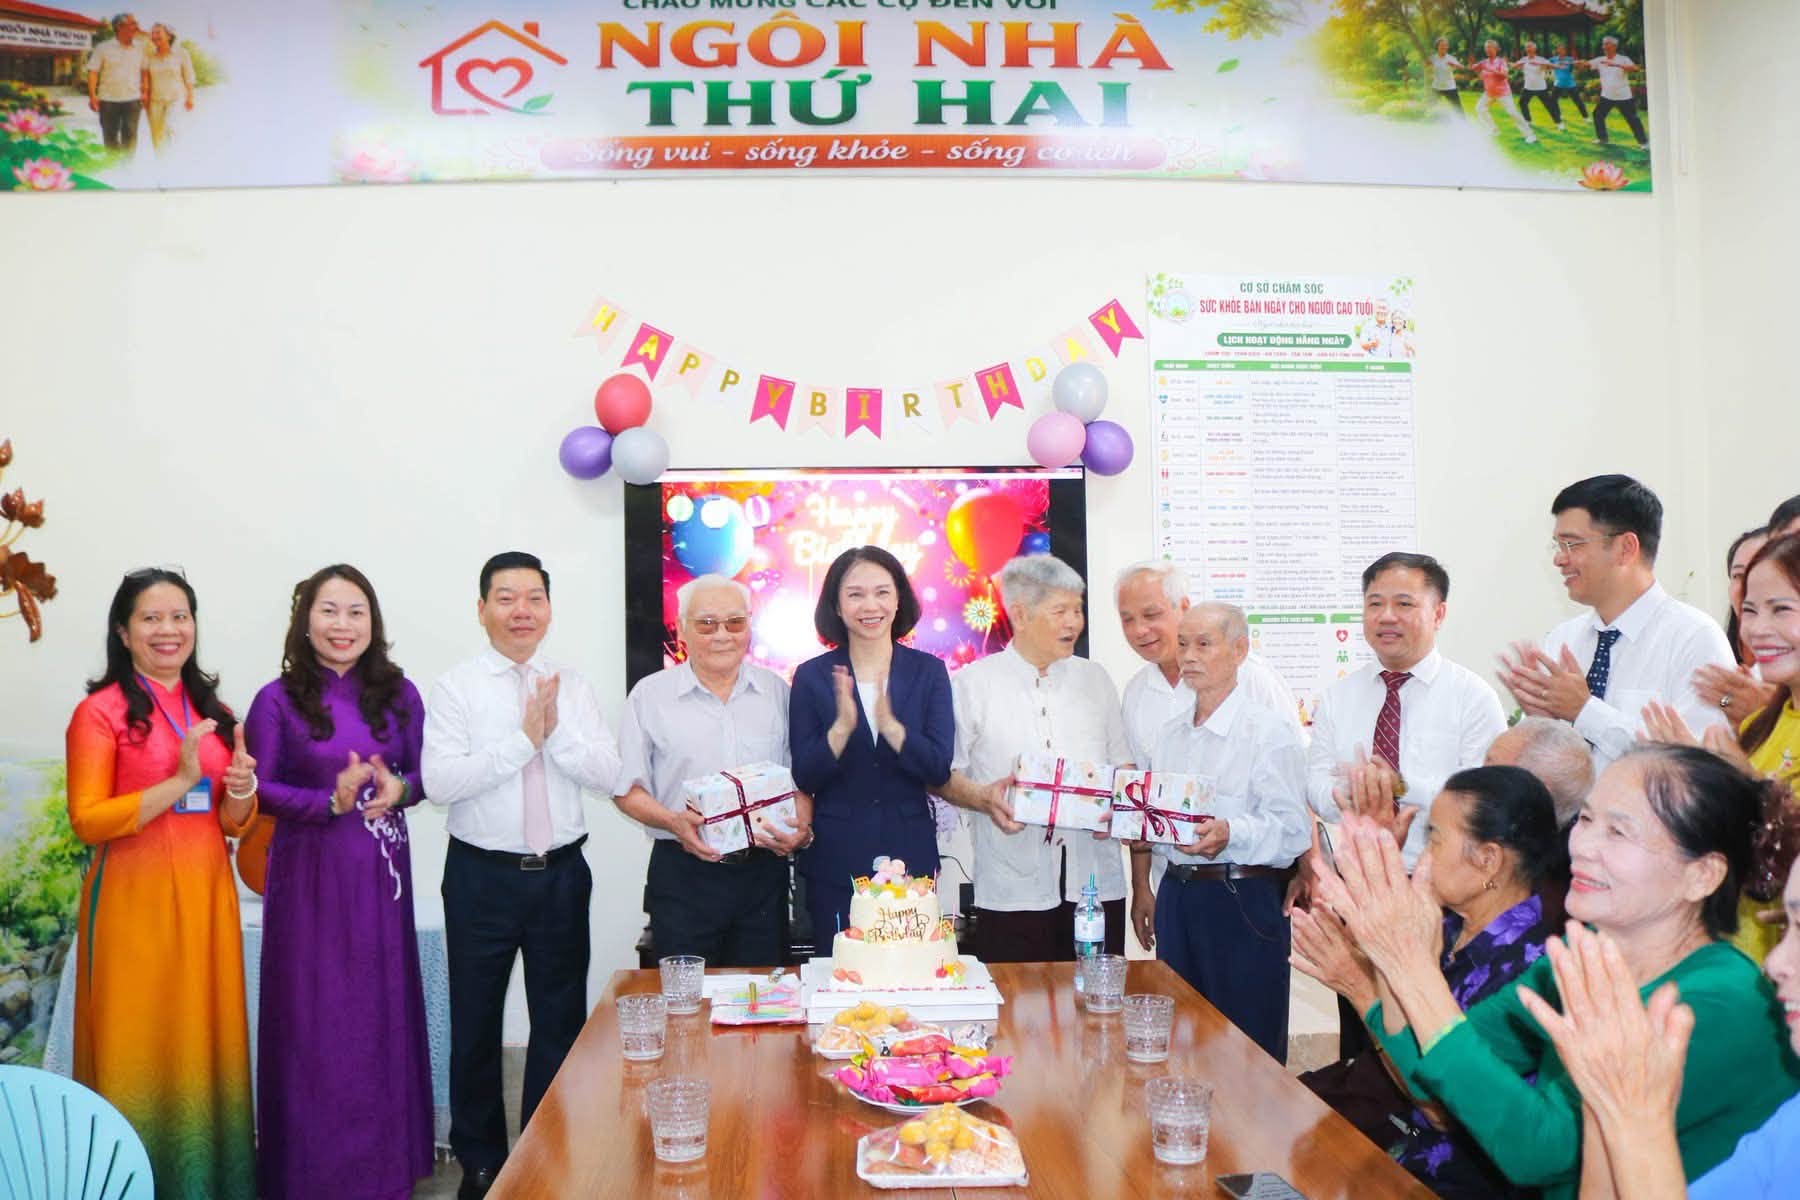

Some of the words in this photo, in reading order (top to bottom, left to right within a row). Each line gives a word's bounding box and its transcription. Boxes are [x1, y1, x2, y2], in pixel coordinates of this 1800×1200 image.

[596, 10, 868, 69] NGÔI
[913, 11, 1174, 71] NHÀ
[625, 68, 872, 127] THỨ
[912, 79, 1133, 129] HAI
[664, 141, 712, 161] vui
[745, 138, 817, 168] sống
[827, 138, 909, 161] khỏe
[946, 137, 1027, 168] sống
[1289, 300, 1306, 315] CHO
[1336, 301, 1353, 316] CAO
